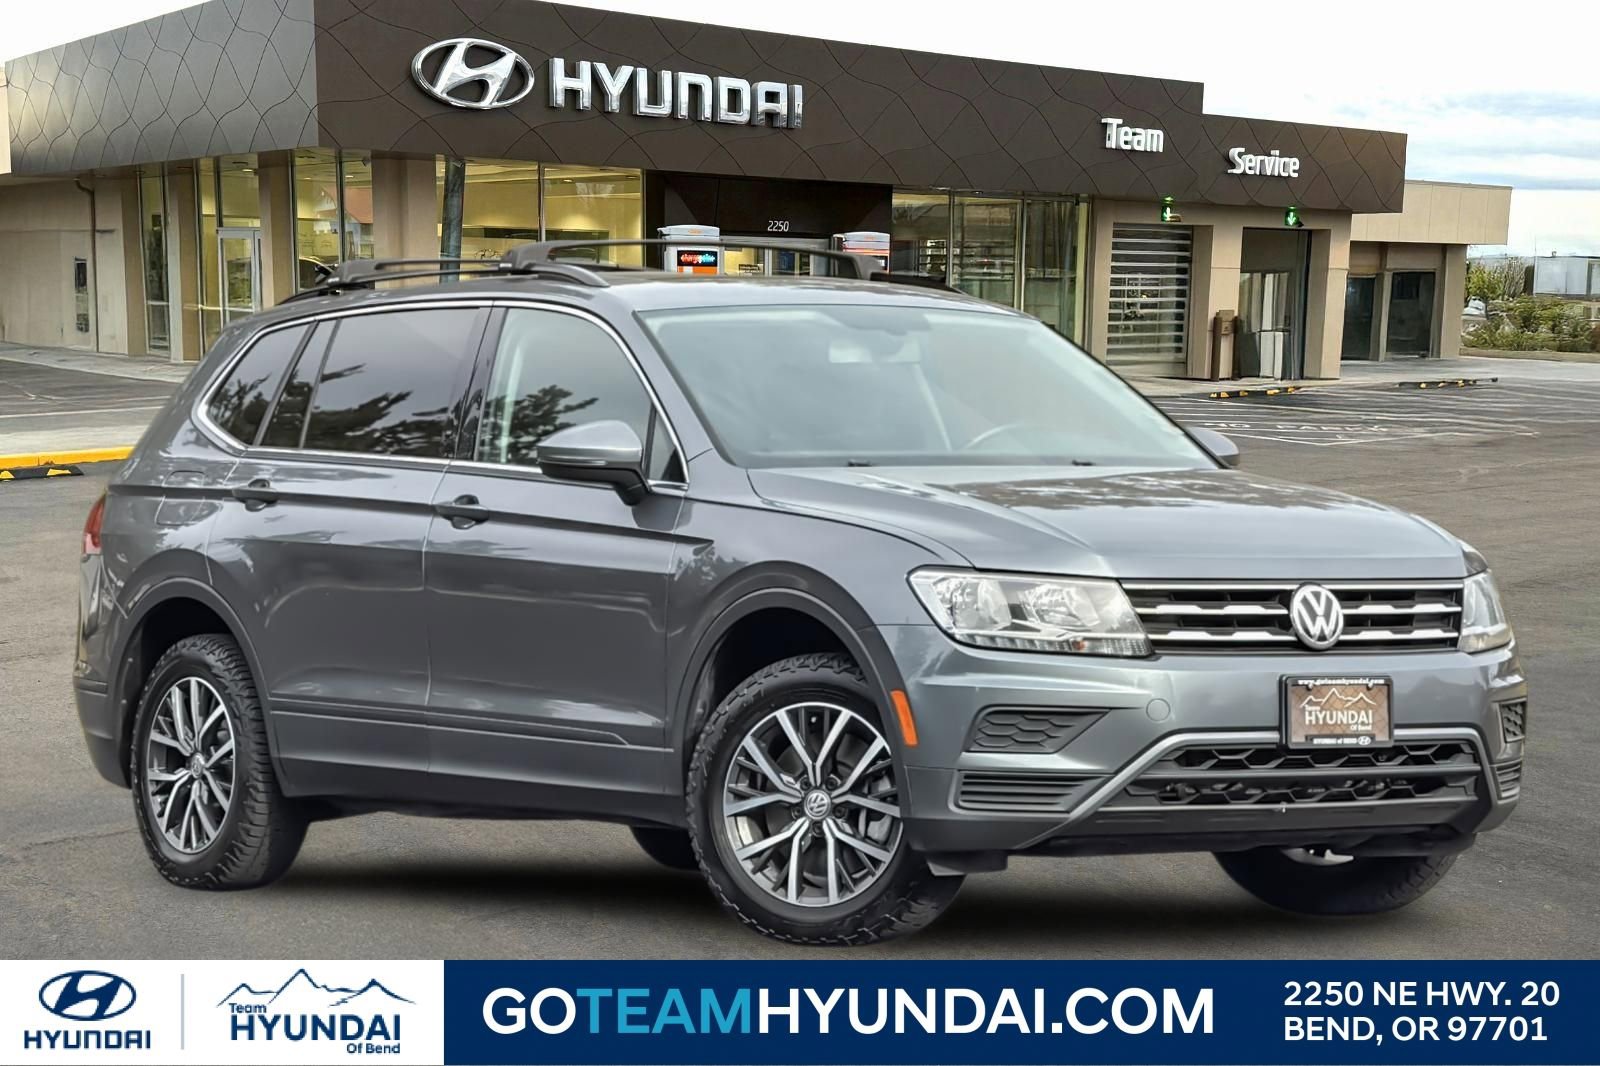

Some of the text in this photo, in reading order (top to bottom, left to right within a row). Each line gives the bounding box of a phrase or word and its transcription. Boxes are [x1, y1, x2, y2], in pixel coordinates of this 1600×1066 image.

[549, 57, 803, 129] HYUNDAI
[1101, 117, 1164, 152] Team
[1227, 147, 1300, 178] Service
[767, 220, 790, 232] 2250
[1305, 710, 1373, 725] HYUNDAI
